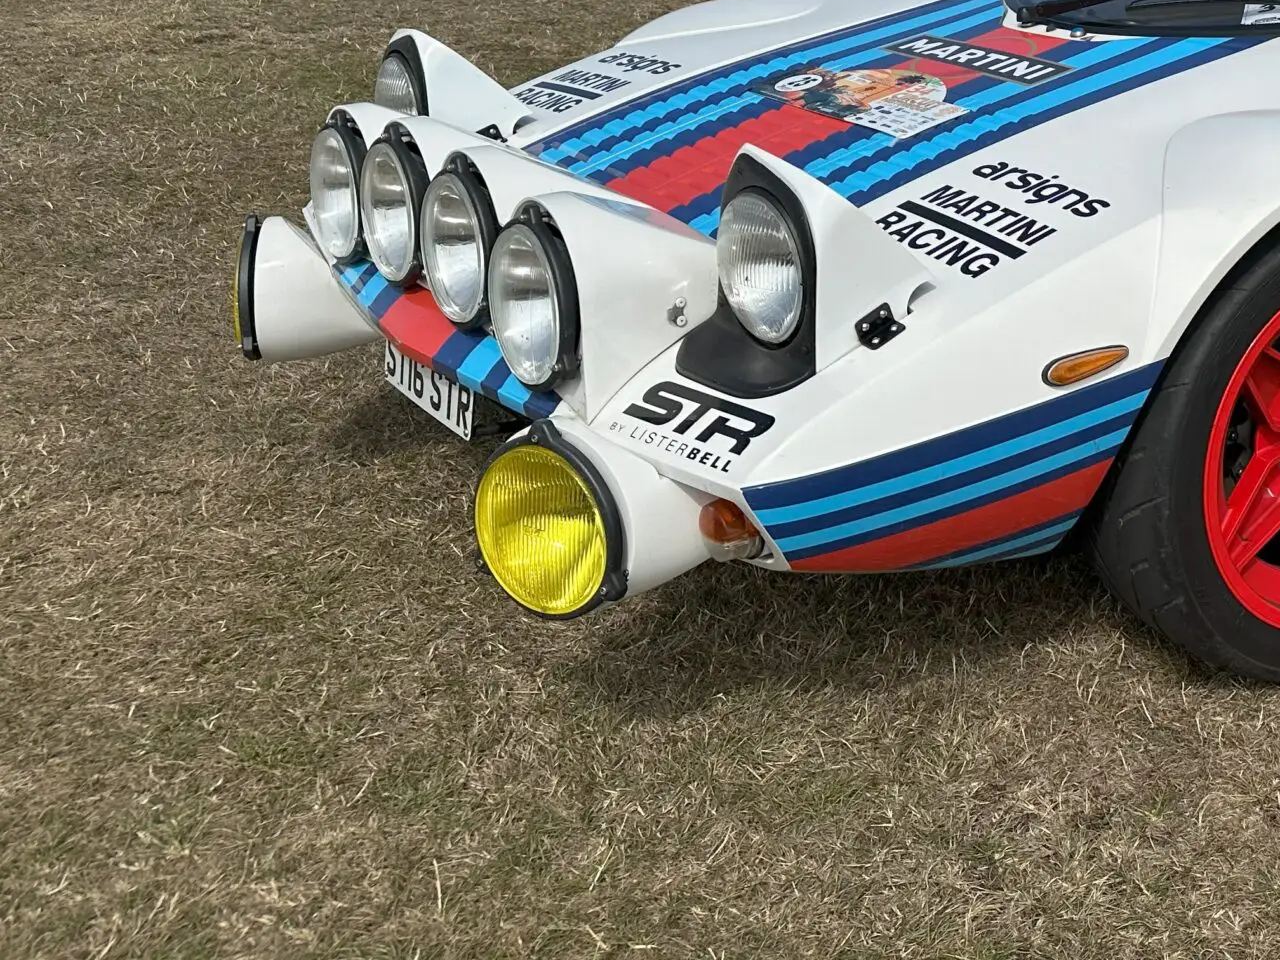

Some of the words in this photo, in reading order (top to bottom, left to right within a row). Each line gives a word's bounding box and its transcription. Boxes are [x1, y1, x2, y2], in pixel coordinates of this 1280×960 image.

[551, 69, 632, 93] MARTINI
[598, 52, 682, 75] arsigns
[898, 39, 1055, 80] MARTINI
[514, 88, 583, 114] RACING
[920, 185, 1057, 246] MARTINI
[972, 161, 1111, 218] arsigns
[875, 210, 1000, 278] RACING
[429, 369, 471, 437] STR
[622, 381, 776, 456] STR
[609, 421, 625, 433] BY
[629, 426, 733, 473] LISTERBELL
